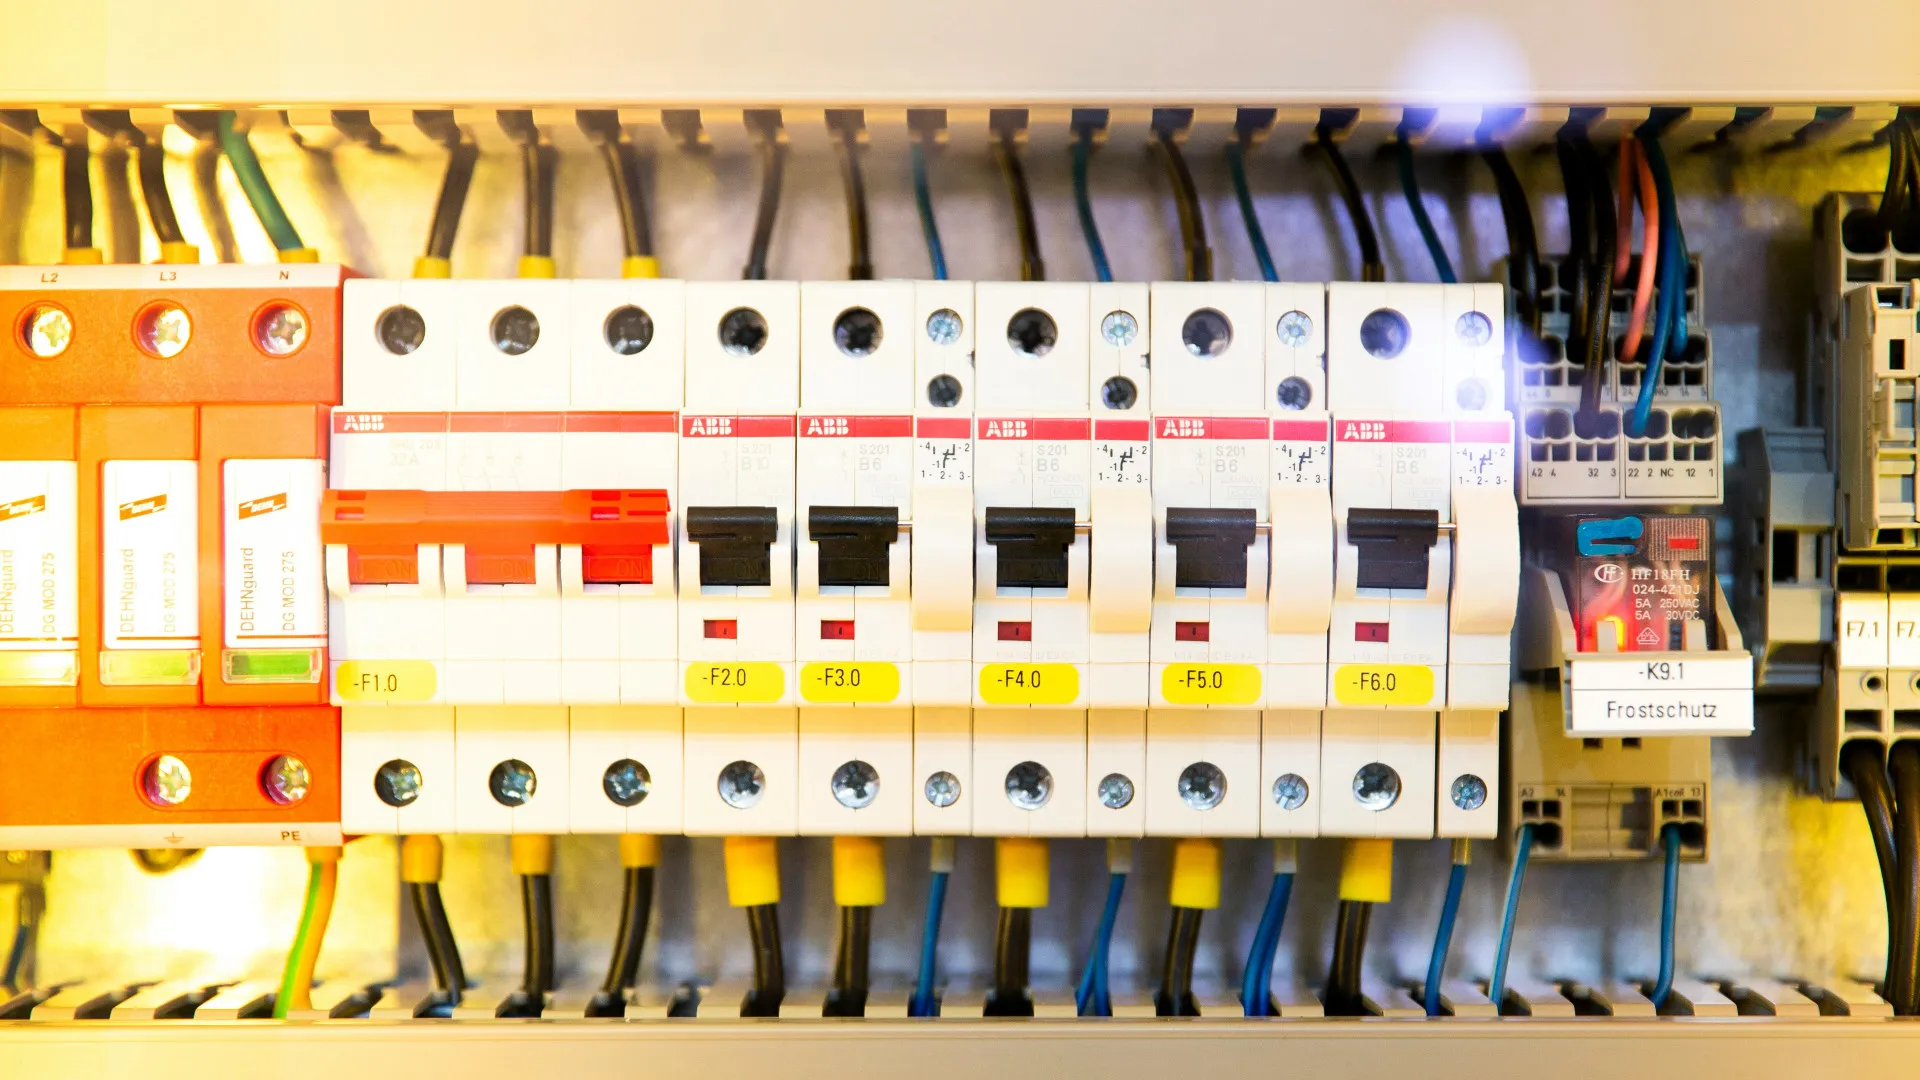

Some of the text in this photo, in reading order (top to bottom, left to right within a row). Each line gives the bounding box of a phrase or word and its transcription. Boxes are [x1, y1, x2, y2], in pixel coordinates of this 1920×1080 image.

[41, 272, 59, 283] L2
[159, 271, 177, 281] L3
[278, 270, 289, 281] N
[343, 414, 385, 431] ABB
[689, 418, 732, 435] ABB
[806, 418, 849, 435] ABB
[985, 420, 1028, 438] ABB
[1163, 420, 1205, 437] ABB
[1343, 422, 1386, 440] ABB
[1531, 468, 1557, 477] 42 4
[1588, 468, 1617, 477] 32 3
[1628, 468, 1639, 477] 22
[1647, 468, 1654, 477] 2
[1660, 468, 1674, 477] NC
[1685, 468, 1696, 477] 12
[42, 553, 55, 574] 275
[1631, 569, 1691, 581] HF18FH
[240, 547, 257, 632] DEHNguard
[282, 551, 295, 631] DG MOD 275
[1632, 584, 1700, 595] 024-4Z1DJ
[1635, 598, 1700, 609] 5A 250VAC
[1635, 610, 1700, 620] 5A 30VDC
[702, 668, 747, 687] -F2.0
[816, 668, 861, 687] -F3.0
[996, 670, 1042, 689] -F4.0
[1638, 662, 1685, 681] -K9.1
[352, 674, 398, 693] -F1.0
[1178, 672, 1223, 690] -F5.0
[1351, 673, 1397, 692] -F6.0
[1606, 701, 1718, 719] Frostschutz
[281, 830, 301, 841] PE
